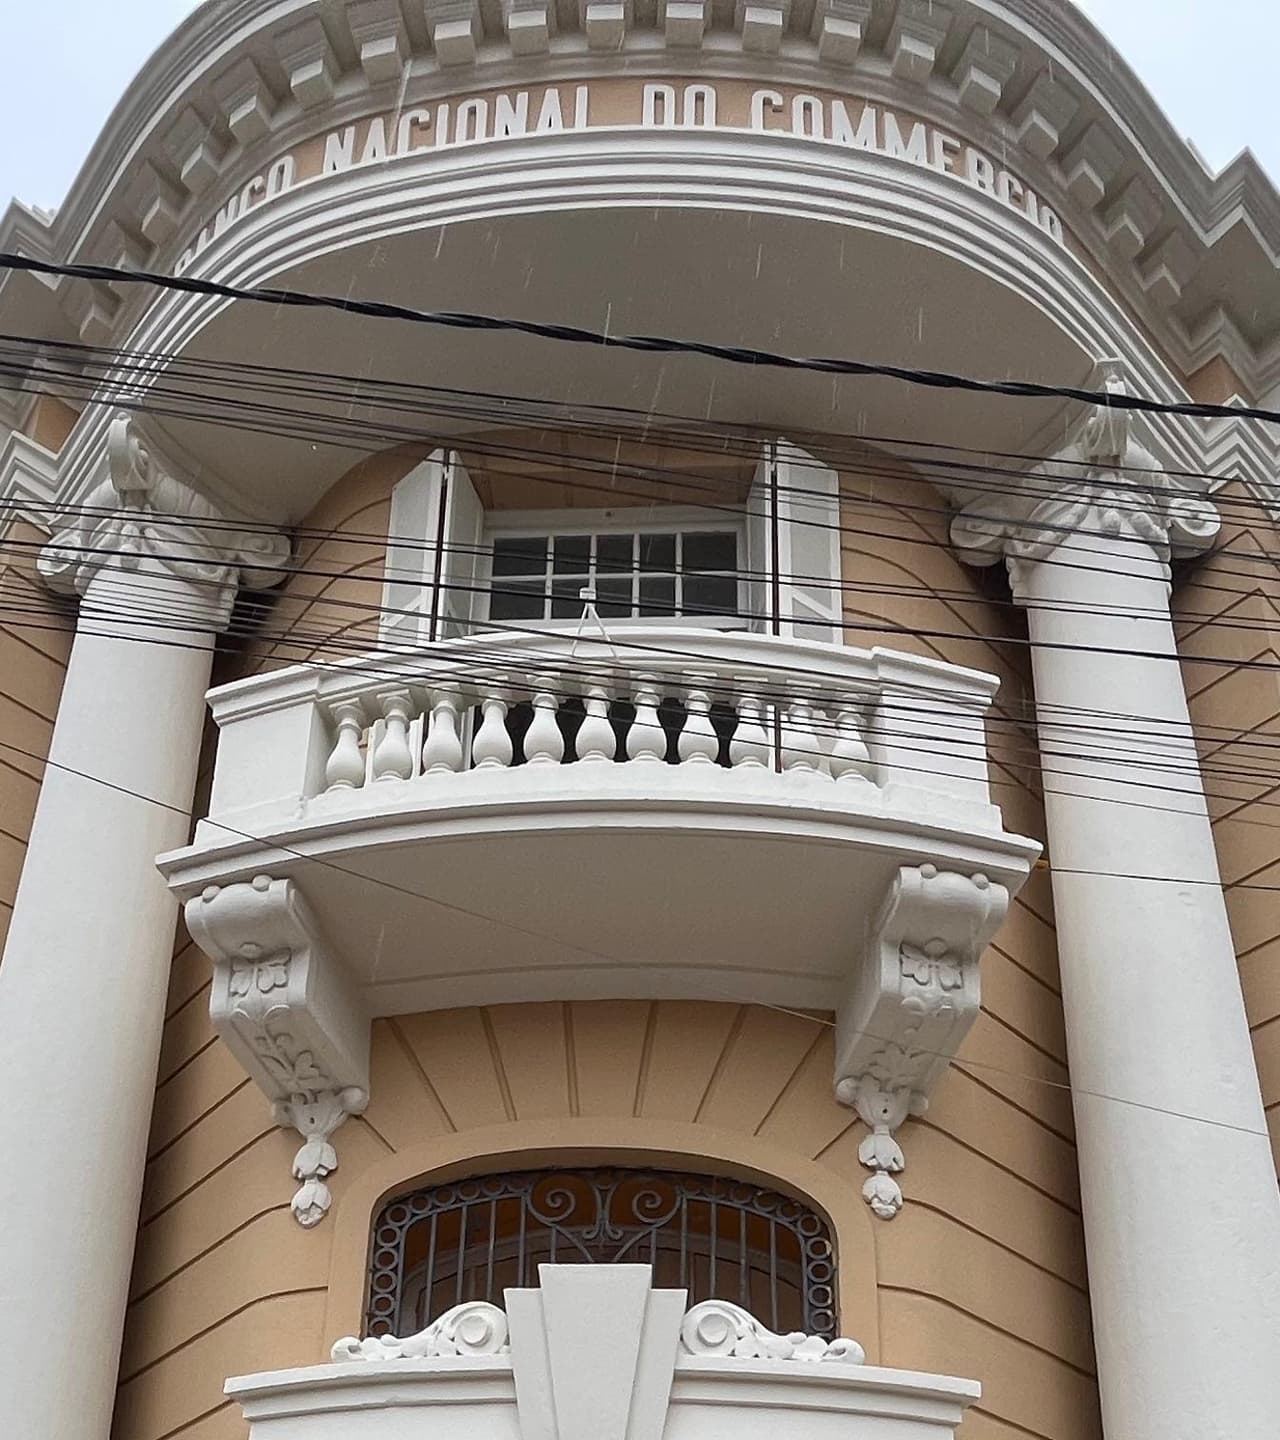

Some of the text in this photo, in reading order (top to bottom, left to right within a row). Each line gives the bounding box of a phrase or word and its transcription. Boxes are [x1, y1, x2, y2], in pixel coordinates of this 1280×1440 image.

[323, 85, 588, 174] NACIONAL
[642, 84, 716, 128] DO
[751, 90, 1064, 247] COMMERCIO
